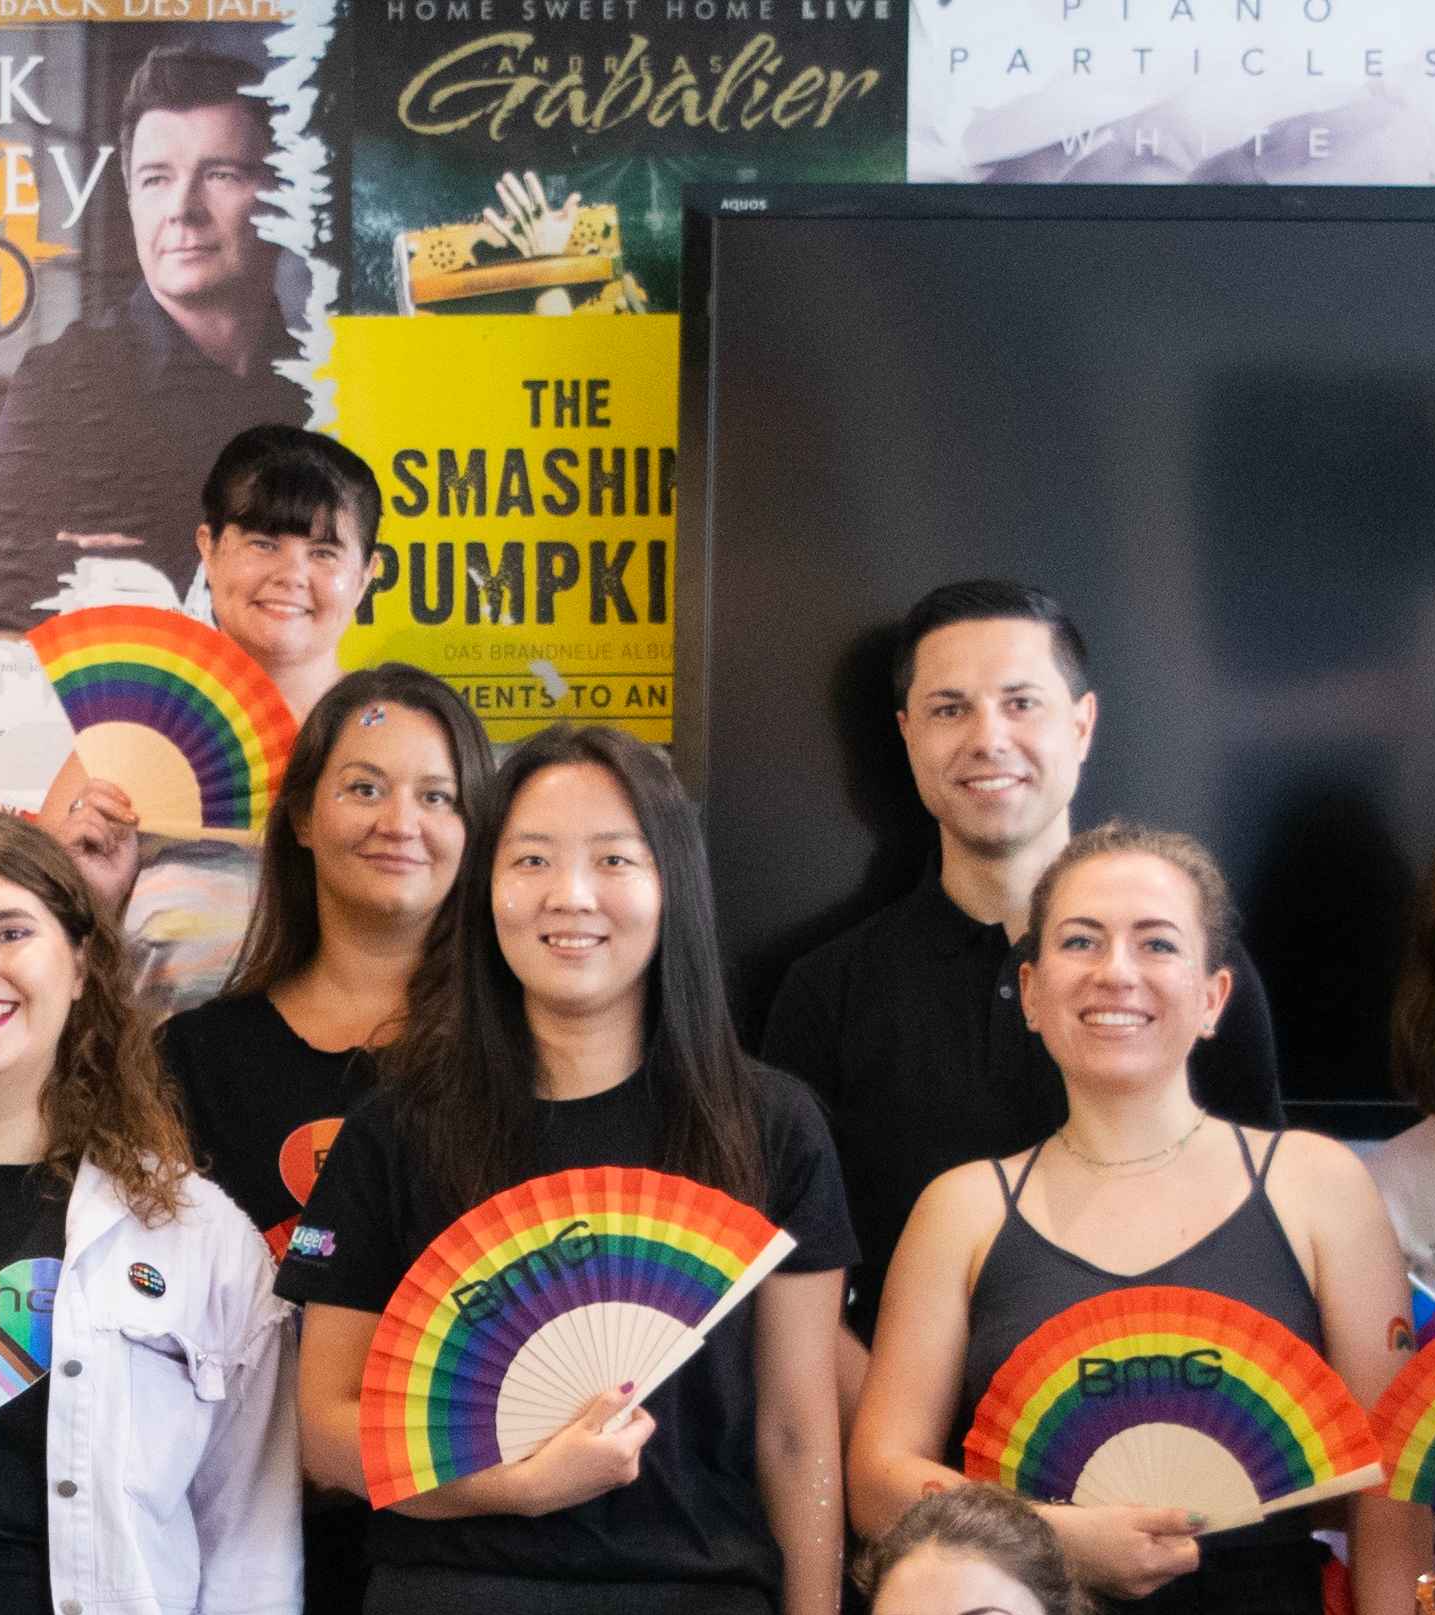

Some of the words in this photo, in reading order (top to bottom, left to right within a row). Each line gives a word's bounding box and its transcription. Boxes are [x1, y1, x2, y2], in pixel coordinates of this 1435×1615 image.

[522, 378, 612, 428] THE
[356, 540, 668, 626] PUMPKI
[571, 685, 613, 708] TO
[450, 1220, 600, 1326] BMG
[1076, 1348, 1225, 1399] BMG
